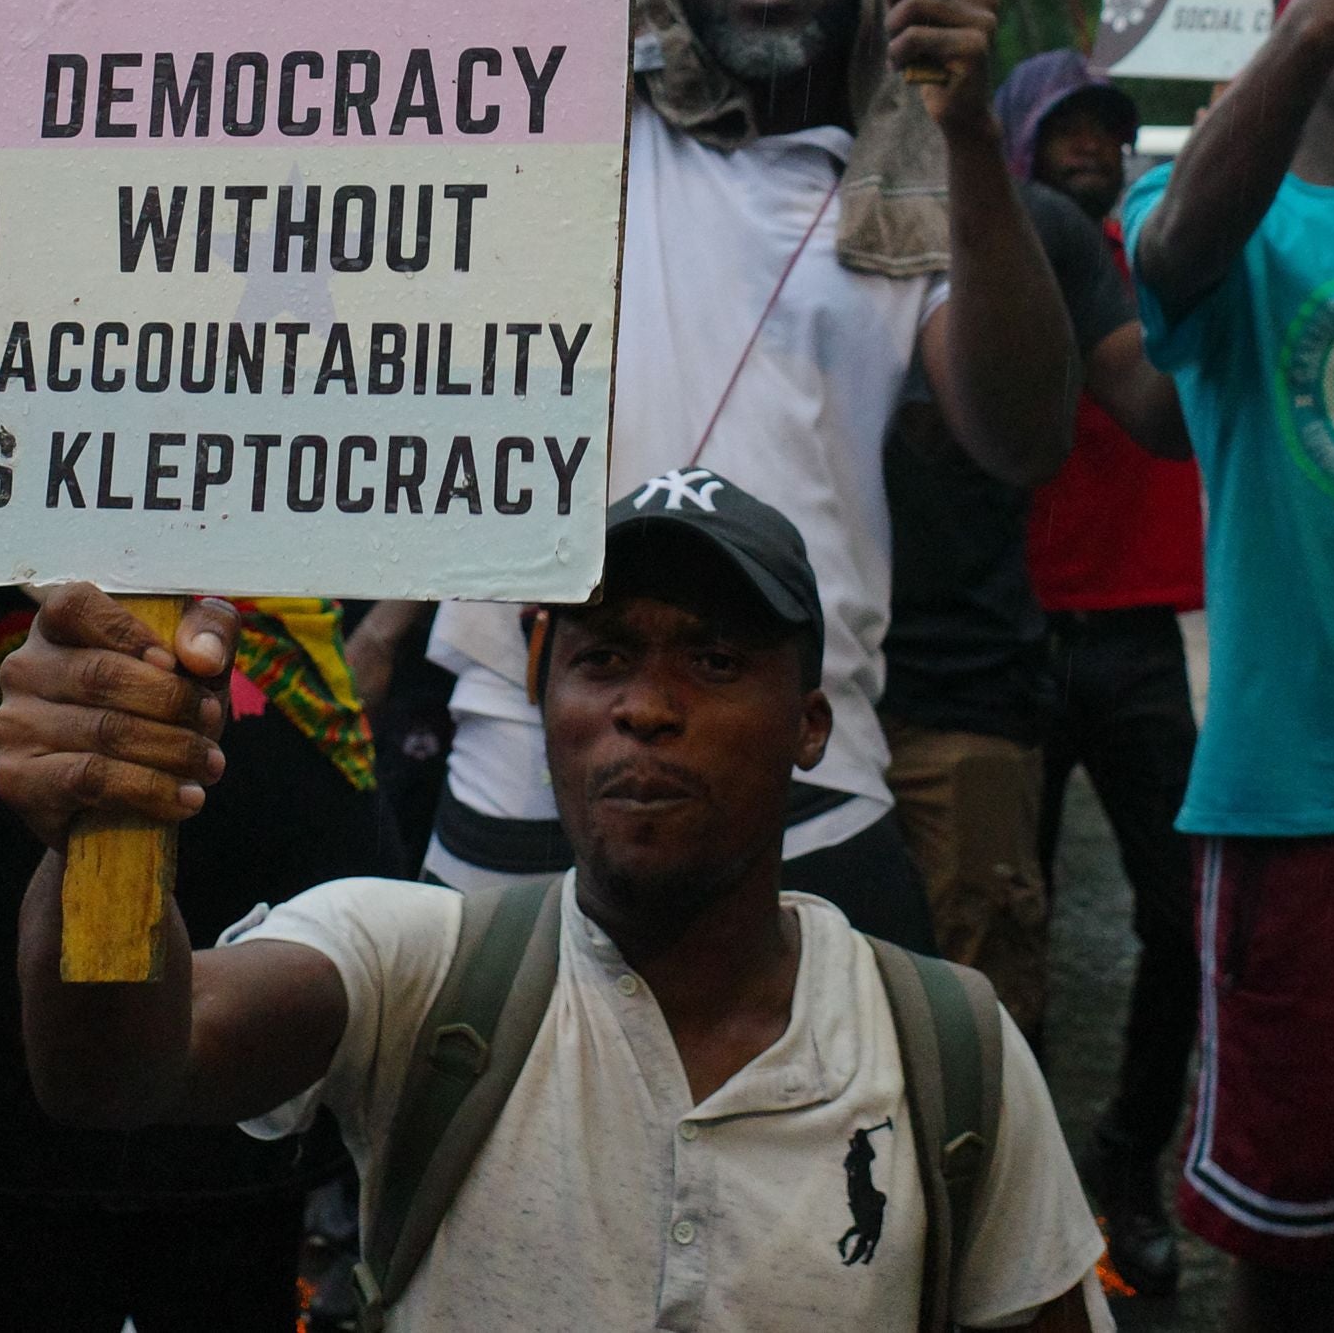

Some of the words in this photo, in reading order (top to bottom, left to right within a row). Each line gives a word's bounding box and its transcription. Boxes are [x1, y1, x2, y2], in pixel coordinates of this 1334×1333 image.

[42, 46, 567, 139] DEMOCRACY
[118, 184, 488, 272] WITHOUT
[46, 431, 590, 516] KLEPTOCRACY
